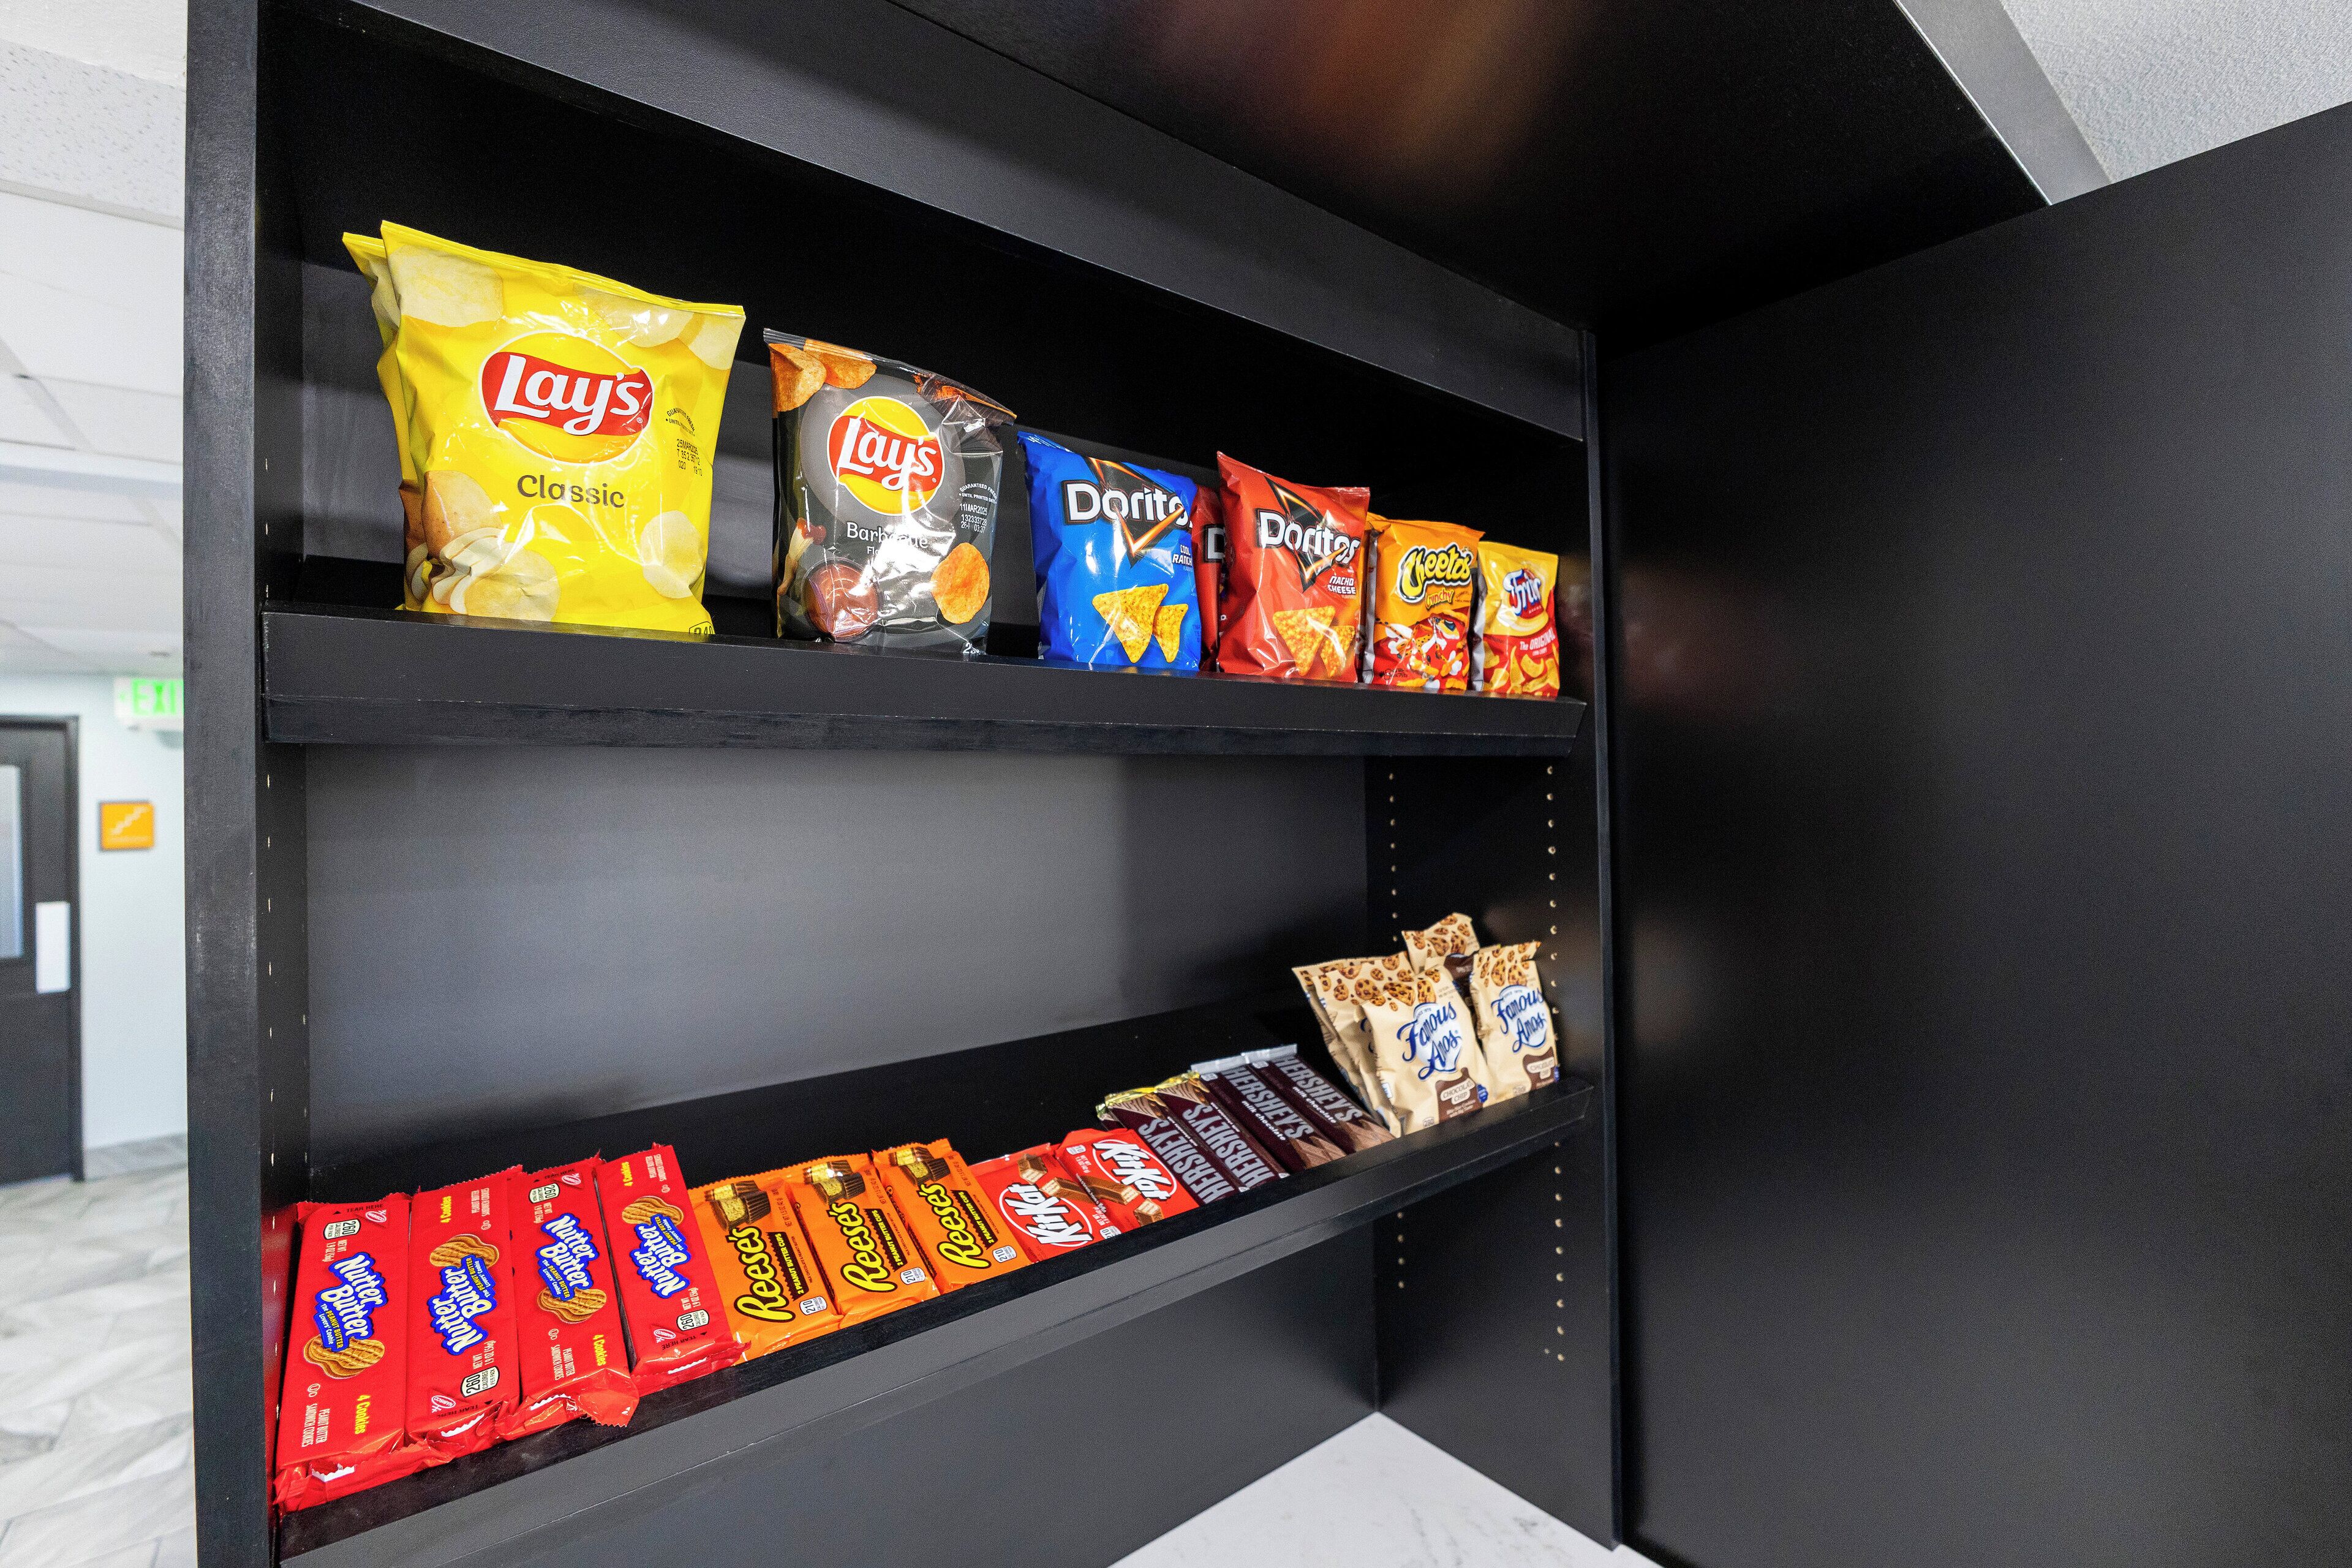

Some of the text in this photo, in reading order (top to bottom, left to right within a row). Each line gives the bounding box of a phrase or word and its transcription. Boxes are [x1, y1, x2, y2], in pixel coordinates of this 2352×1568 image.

[493, 354, 645, 435] Lay's
[839, 417, 937, 491] Lay's
[516, 474, 625, 509] Classic
[959, 483, 987, 492] GUARANTEED
[1066, 481, 1193, 528] Dorito
[1180, 544, 1191, 556] COOL
[1260, 511, 1360, 565] Doritos
[1172, 554, 1193, 566] RANCH
[1400, 544, 1472, 599] Cheetos
[1327, 584, 1356, 594] CHEESE
[1329, 575, 1354, 586] NACHO
[1425, 587, 1454, 609] Crunchy
[1491, 987, 1544, 1035] Famous
[1396, 1001, 1457, 1062] Famous
[1512, 1011, 1547, 1053] Amos
[1418, 1030, 1462, 1080] Amos
[1220, 1065, 1314, 1139] HERSHEY'S
[1272, 1055, 1363, 1122] HERSHEY'S
[1242, 1101, 1286, 1140] milk chocolate
[1292, 1087, 1336, 1123] milk chocolate
[1138, 1118, 1235, 1204] HERSHEY'S
[1182, 1103, 1274, 1188] HERSHEY'S
[621, 1161, 633, 1182] Cookies
[440, 1196, 451, 1218] Cookies
[544, 1185, 556, 1198] 260
[959, 1192, 969, 1204] CUPS
[342, 1221, 356, 1235] 260
[655, 1216, 666, 1231] BUTTER
[872, 1209, 883, 1223] CUPS
[918, 1184, 990, 1267] Reese's
[967, 1204, 980, 1221] BUTTER
[545, 1215, 595, 1259] Nutter
[663, 1231, 677, 1245] PEANUT
[775, 1232, 785, 1247] CUPS
[878, 1223, 892, 1242] BUTTER
[978, 1220, 992, 1240] PEANUT
[638, 1226, 687, 1267] Butter
[781, 1246, 795, 1267] BUTTER
[829, 1203, 895, 1291] Reese's
[888, 1241, 901, 1262] PEANUT
[995, 1250, 1008, 1262] 210
[334, 1255, 383, 1305] Nutter
[466, 1257, 475, 1275] BUTTER
[540, 1242, 589, 1287] Butter
[634, 1251, 686, 1295] Nutter
[728, 1227, 793, 1321] Reese's
[789, 1267, 803, 1291] PEANUT
[903, 1271, 916, 1283] 210
[445, 1268, 492, 1319] Butter
[472, 1275, 485, 1291] PEANUT
[548, 1265, 563, 1281] PEANUT
[559, 1280, 570, 1298] BUTTER
[321, 1284, 369, 1336] Butter
[680, 1314, 695, 1329] 260
[803, 1300, 816, 1313] 210
[325, 1310, 341, 1328] PEANUT
[334, 1328, 344, 1349] BUTTER
[326, 1329, 335, 1344] Cookie
[432, 1298, 483, 1352] Nutter
[594, 1339, 608, 1366] Cookies
[662, 1340, 679, 1350] HERE
[473, 1360, 483, 1370] NET
[551, 1344, 565, 1381] SANDWICH COOKIES
[563, 1348, 576, 1377] PEANUT BUTTER
[466, 1374, 480, 1393] 260
[301, 1403, 318, 1447] SANDWICH COOKIES
[315, 1409, 330, 1444] PEANUT BUTTER
[355, 1401, 370, 1434] Cookies
